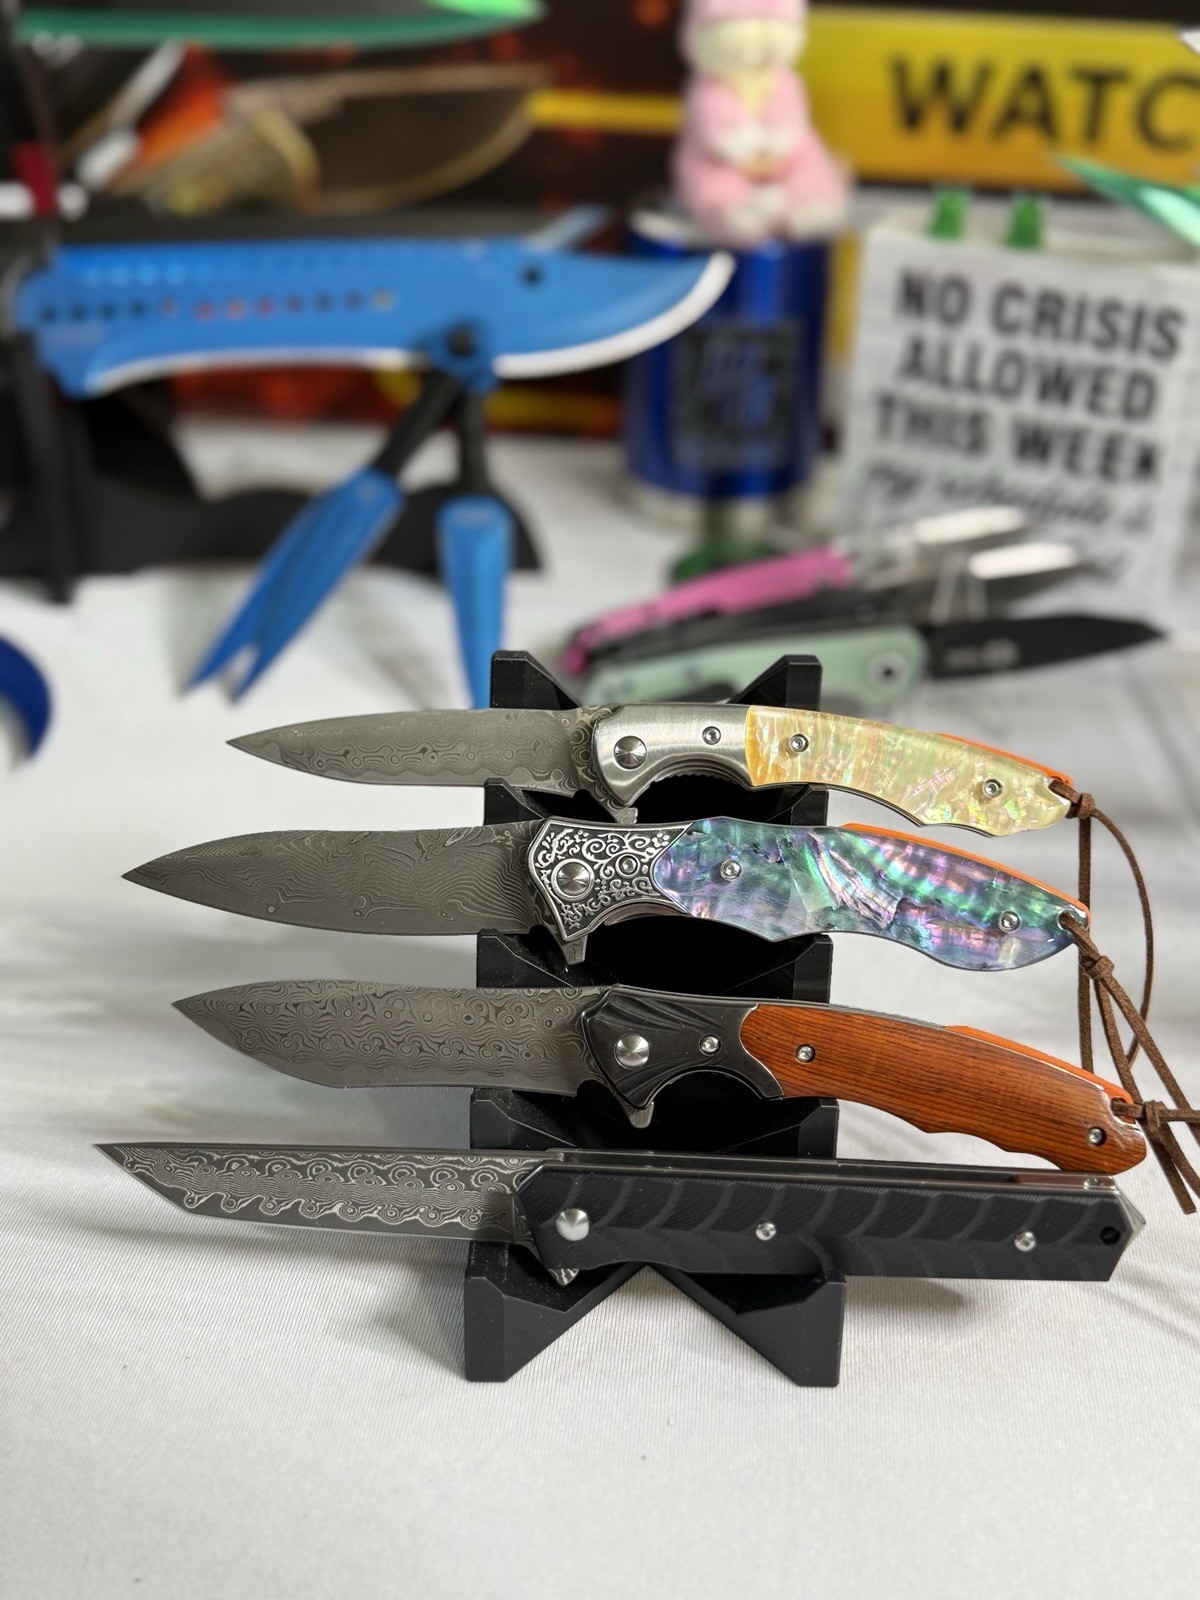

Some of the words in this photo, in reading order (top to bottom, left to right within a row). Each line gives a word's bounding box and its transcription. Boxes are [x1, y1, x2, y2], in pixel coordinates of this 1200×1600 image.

[898, 268, 972, 328] NO
[992, 283, 1185, 361] CRISIS
[900, 336, 1158, 423] ALLOWED
[876, 391, 987, 454] THIS
[1012, 419, 1158, 484] WEEK
